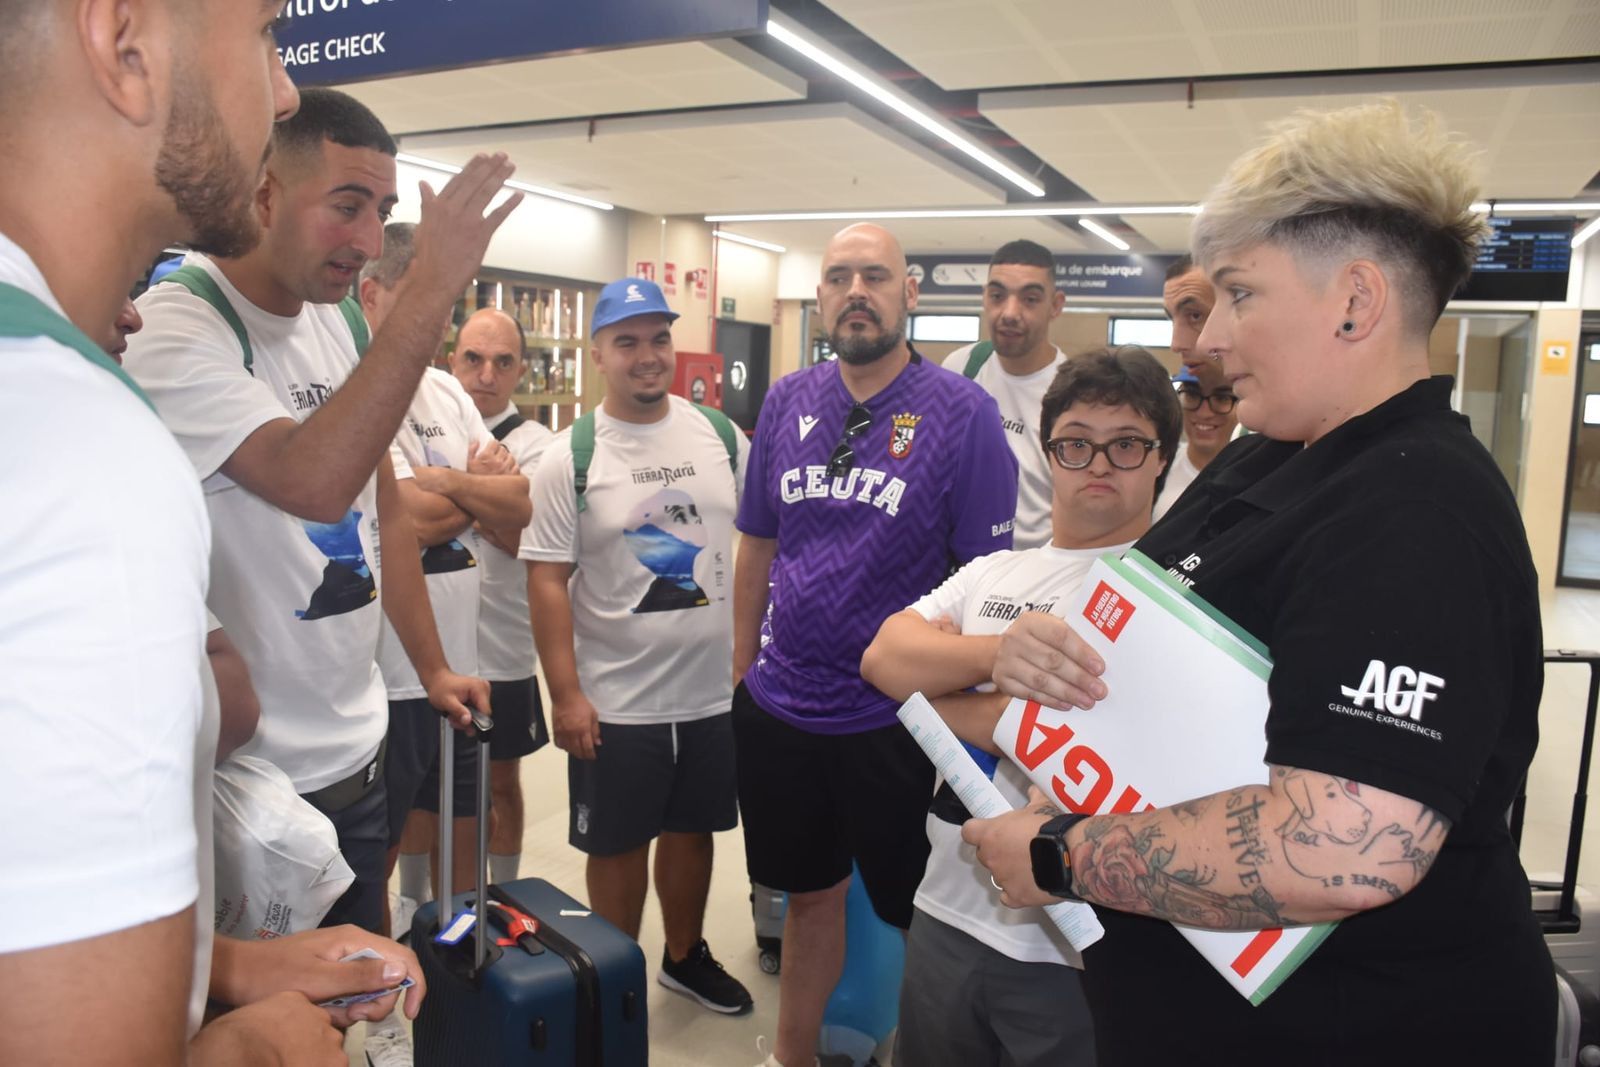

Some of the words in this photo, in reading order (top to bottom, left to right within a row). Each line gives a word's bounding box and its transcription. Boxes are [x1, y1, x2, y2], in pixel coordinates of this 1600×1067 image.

[324, 32, 386, 61] CHECK
[1068, 264, 1083, 275] de
[1085, 264, 1143, 279] embarque
[632, 470, 664, 484] TIERRA
[781, 465, 907, 517] CEUTA
[978, 600, 1022, 621] TIERRA
[1341, 659, 1446, 720] AGF
[1328, 703, 1373, 719] GENUINE
[1376, 714, 1442, 741] EXPERIENCES
